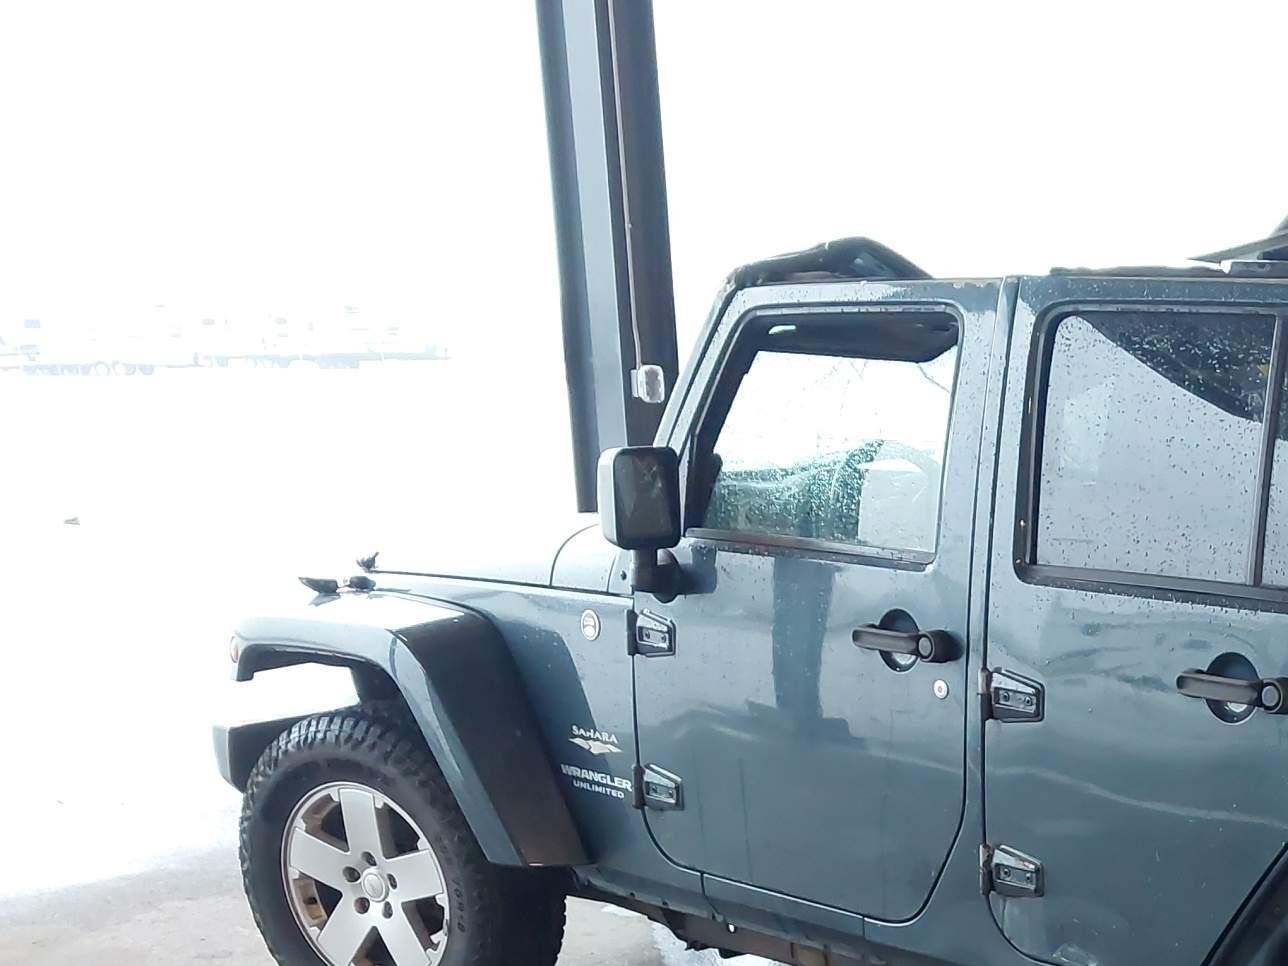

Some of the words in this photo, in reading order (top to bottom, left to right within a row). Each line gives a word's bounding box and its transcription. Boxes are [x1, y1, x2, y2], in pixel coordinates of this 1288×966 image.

[571, 725, 619, 744] SAHARA
[560, 763, 633, 792] WRANGLER
[572, 780, 625, 799] UNLIMITED
